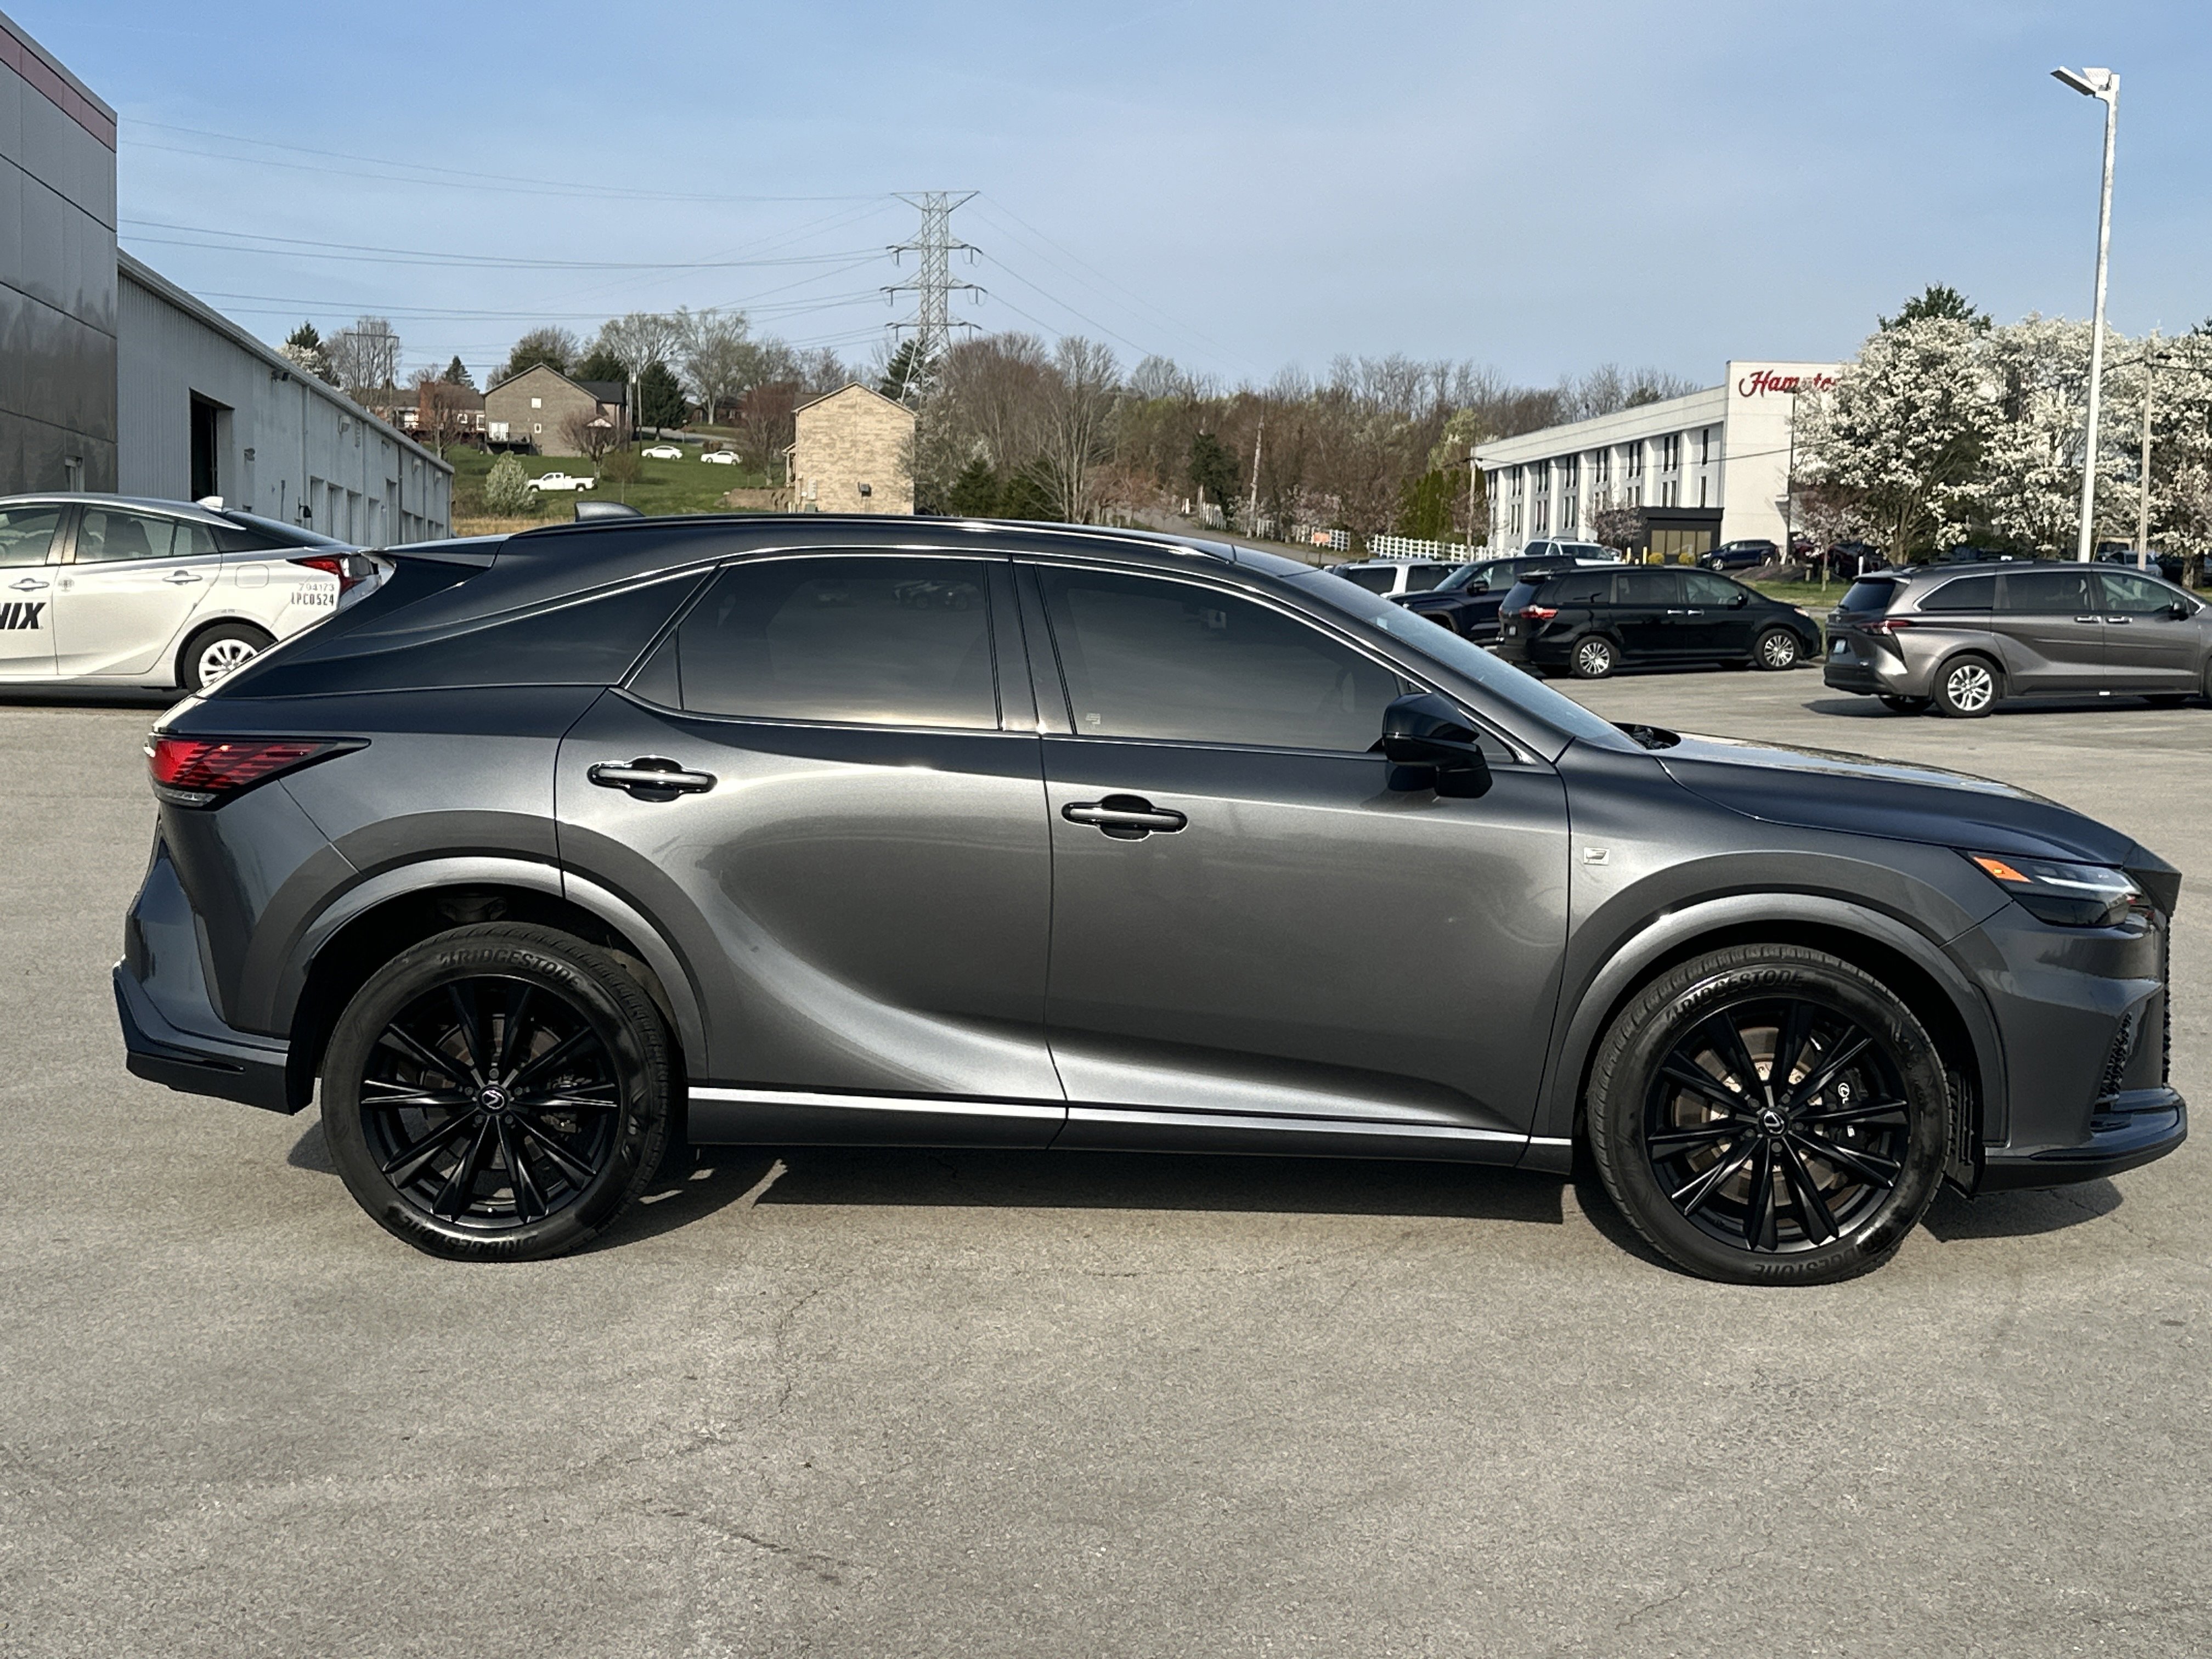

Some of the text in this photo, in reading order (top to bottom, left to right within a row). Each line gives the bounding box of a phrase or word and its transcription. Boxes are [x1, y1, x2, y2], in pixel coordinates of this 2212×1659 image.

[1739, 369, 1837, 398] Hamto
[439, 949, 582, 986] BRIDGESTONE
[1667, 969, 1803, 1022] BRIDGESTONE
